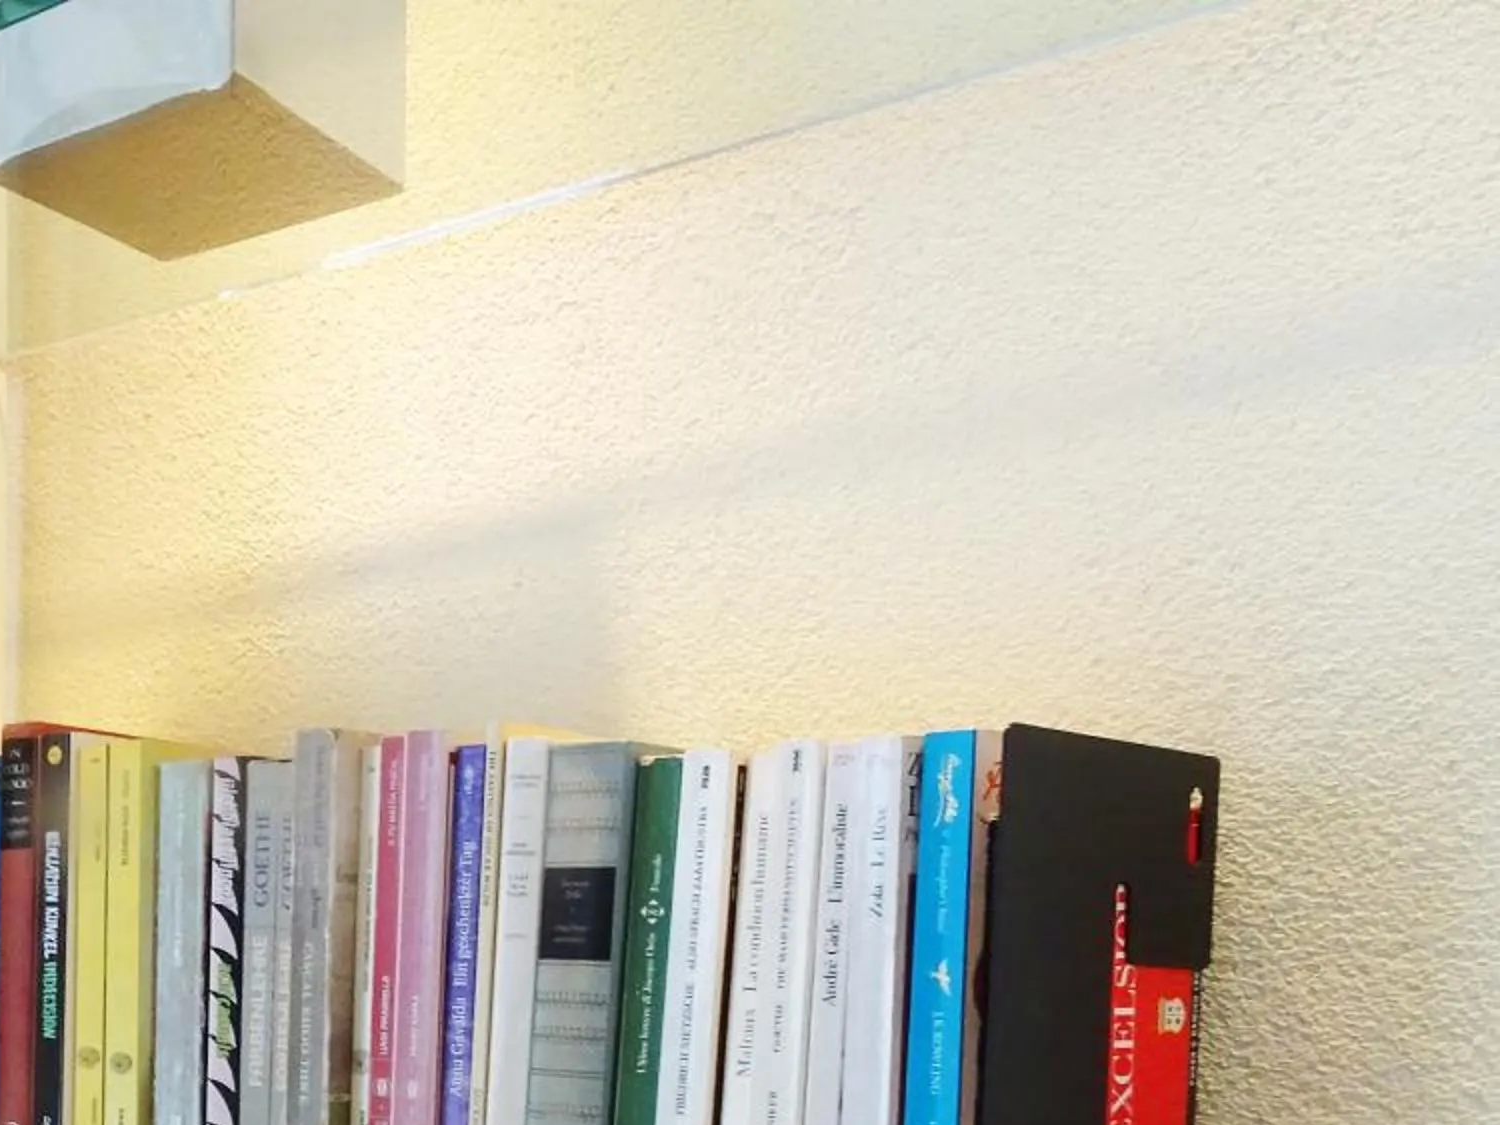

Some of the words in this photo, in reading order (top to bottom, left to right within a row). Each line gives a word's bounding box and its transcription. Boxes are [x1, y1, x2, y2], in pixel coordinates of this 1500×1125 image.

[252, 808, 272, 908] GOETHE
[823, 919, 841, 955] Gide
[453, 960, 469, 987] Ein
[821, 960, 839, 1007] André
[450, 997, 467, 1056] Gavalda
[448, 1059, 465, 1097] Anna
